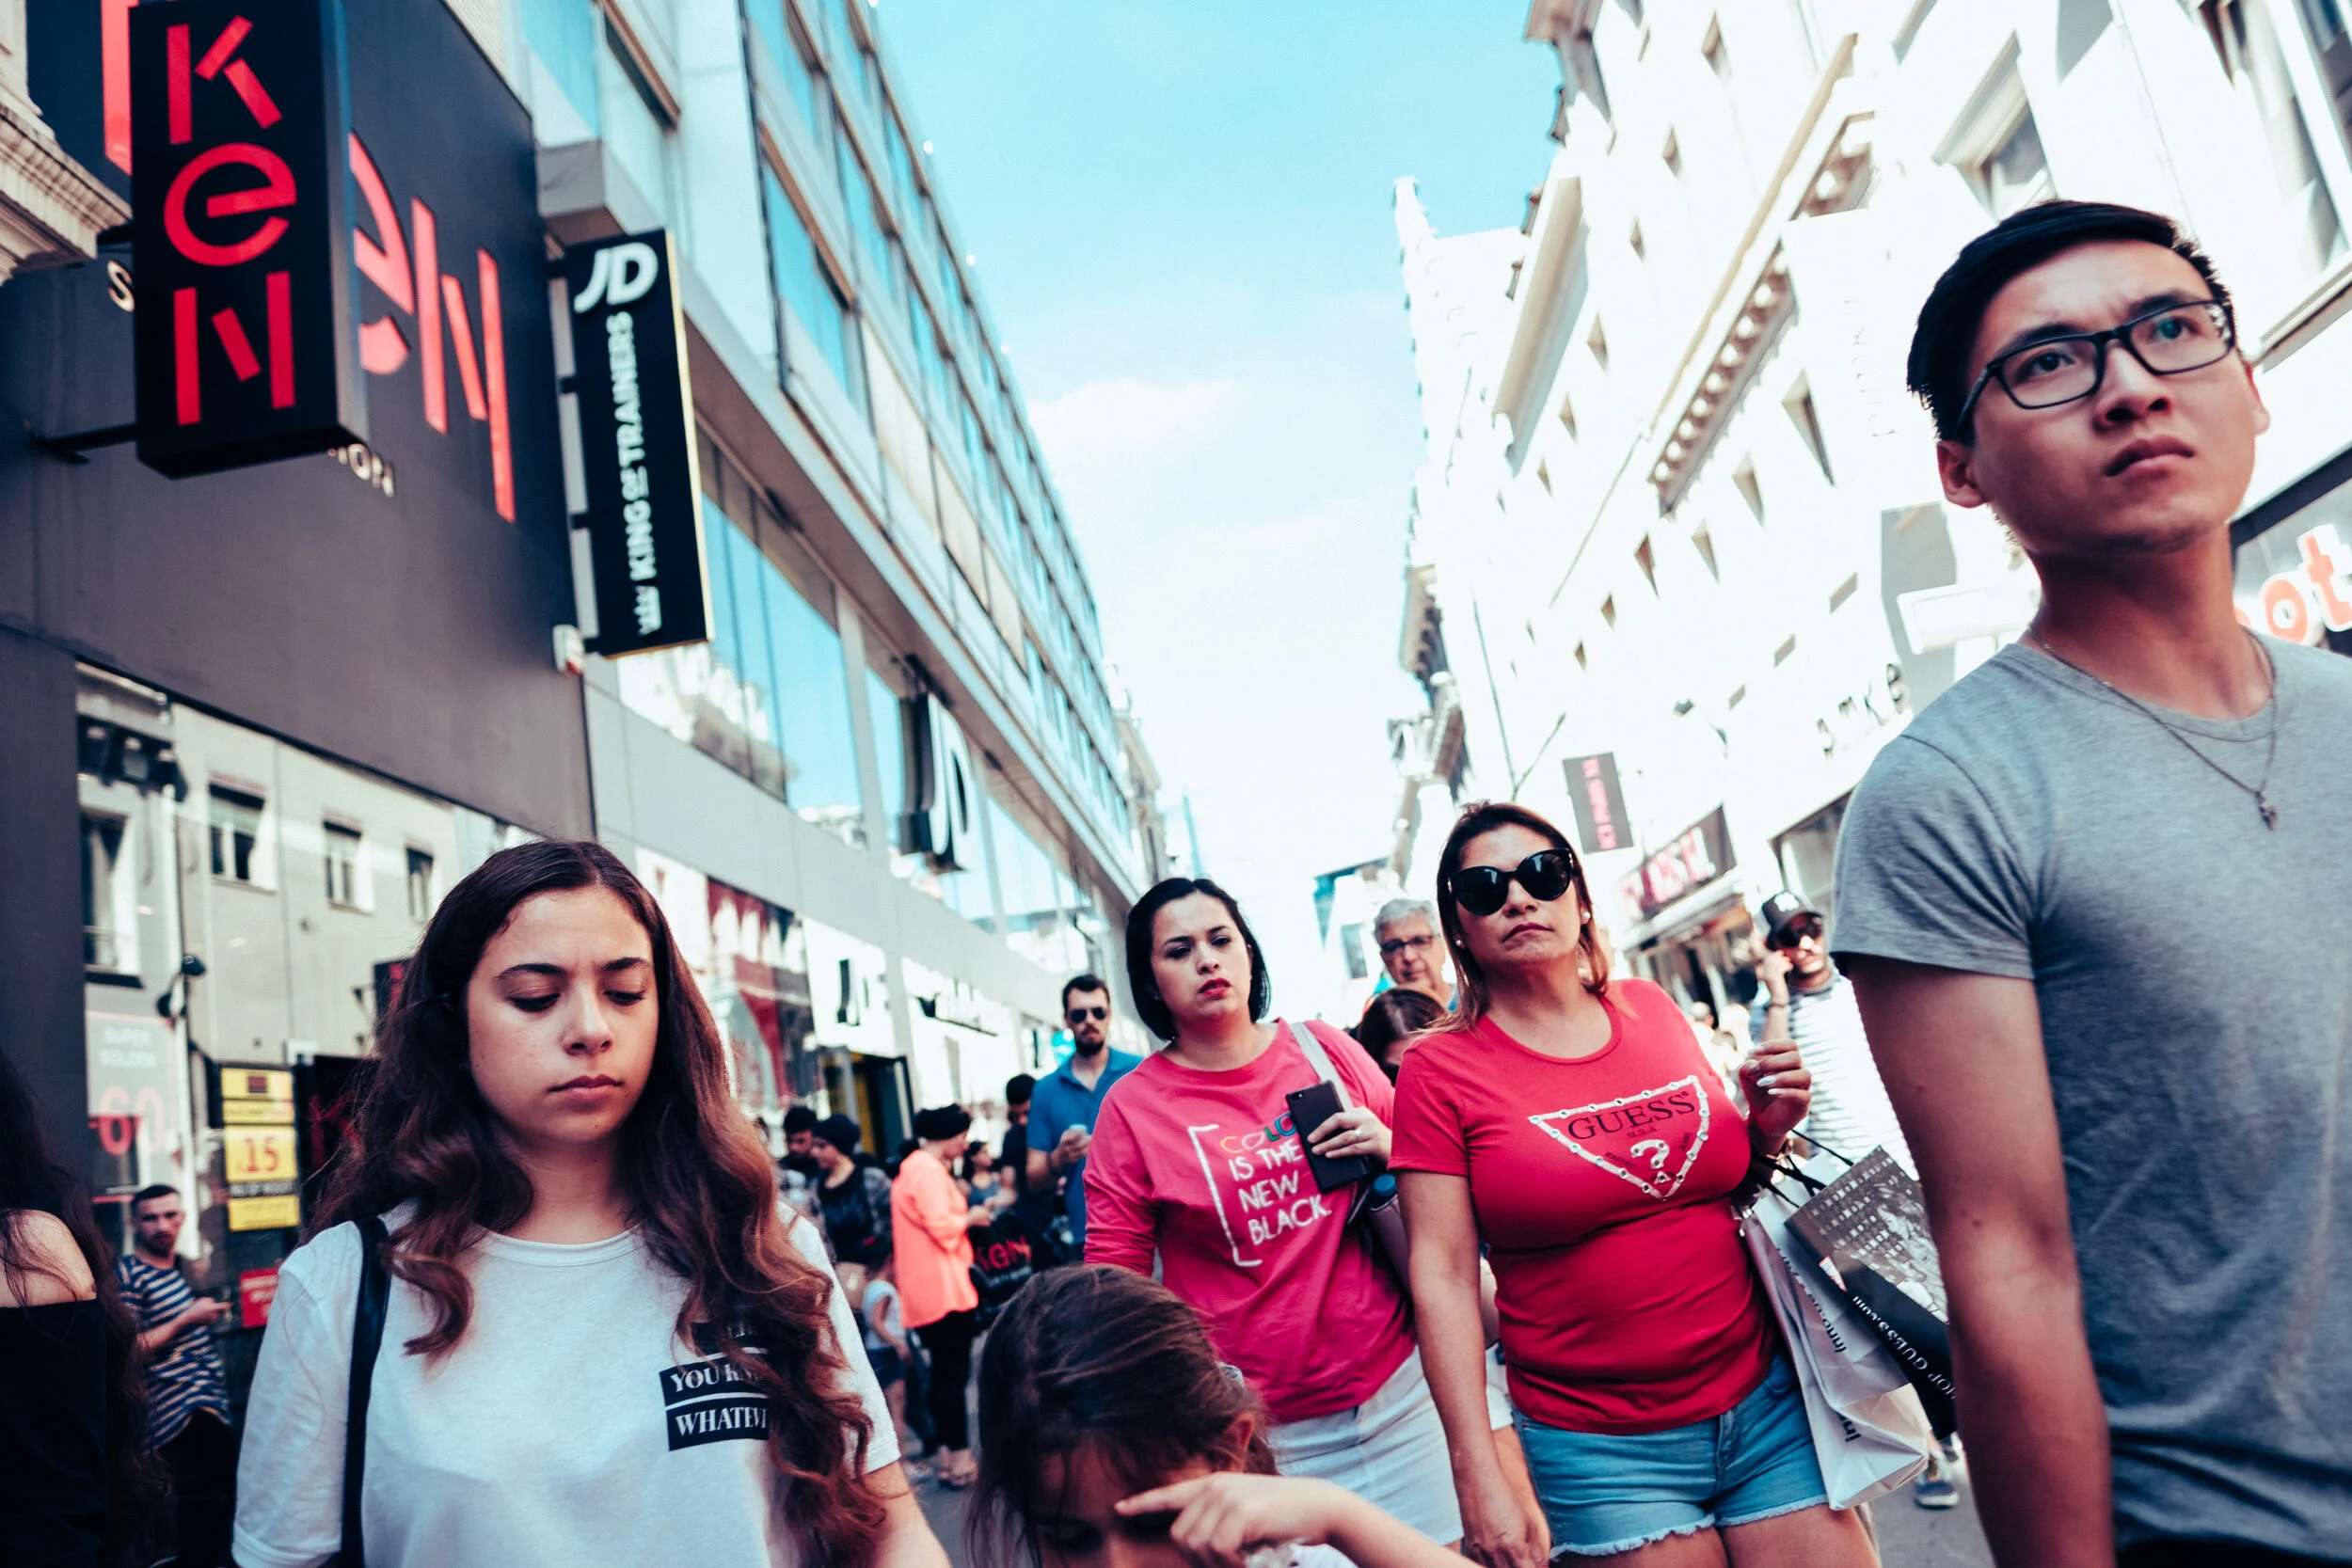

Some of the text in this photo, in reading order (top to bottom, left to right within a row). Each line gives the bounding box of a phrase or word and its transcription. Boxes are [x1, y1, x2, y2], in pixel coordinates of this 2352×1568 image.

[574, 242, 659, 314] JD
[606, 310, 646, 467] TRAINERS
[624, 499, 658, 581] KING
[2233, 532, 2352, 643] ot
[1220, 1112, 1297, 1154] COLO
[1567, 1094, 1695, 1140] GUESS
[1229, 1138, 1304, 1181] IS THE
[1604, 1151, 1635, 1169] WASHED
[1238, 1170, 1298, 1213] NEW
[670, 1366, 720, 1392] YOU
[1927, 1372, 1957, 1400] HOP
